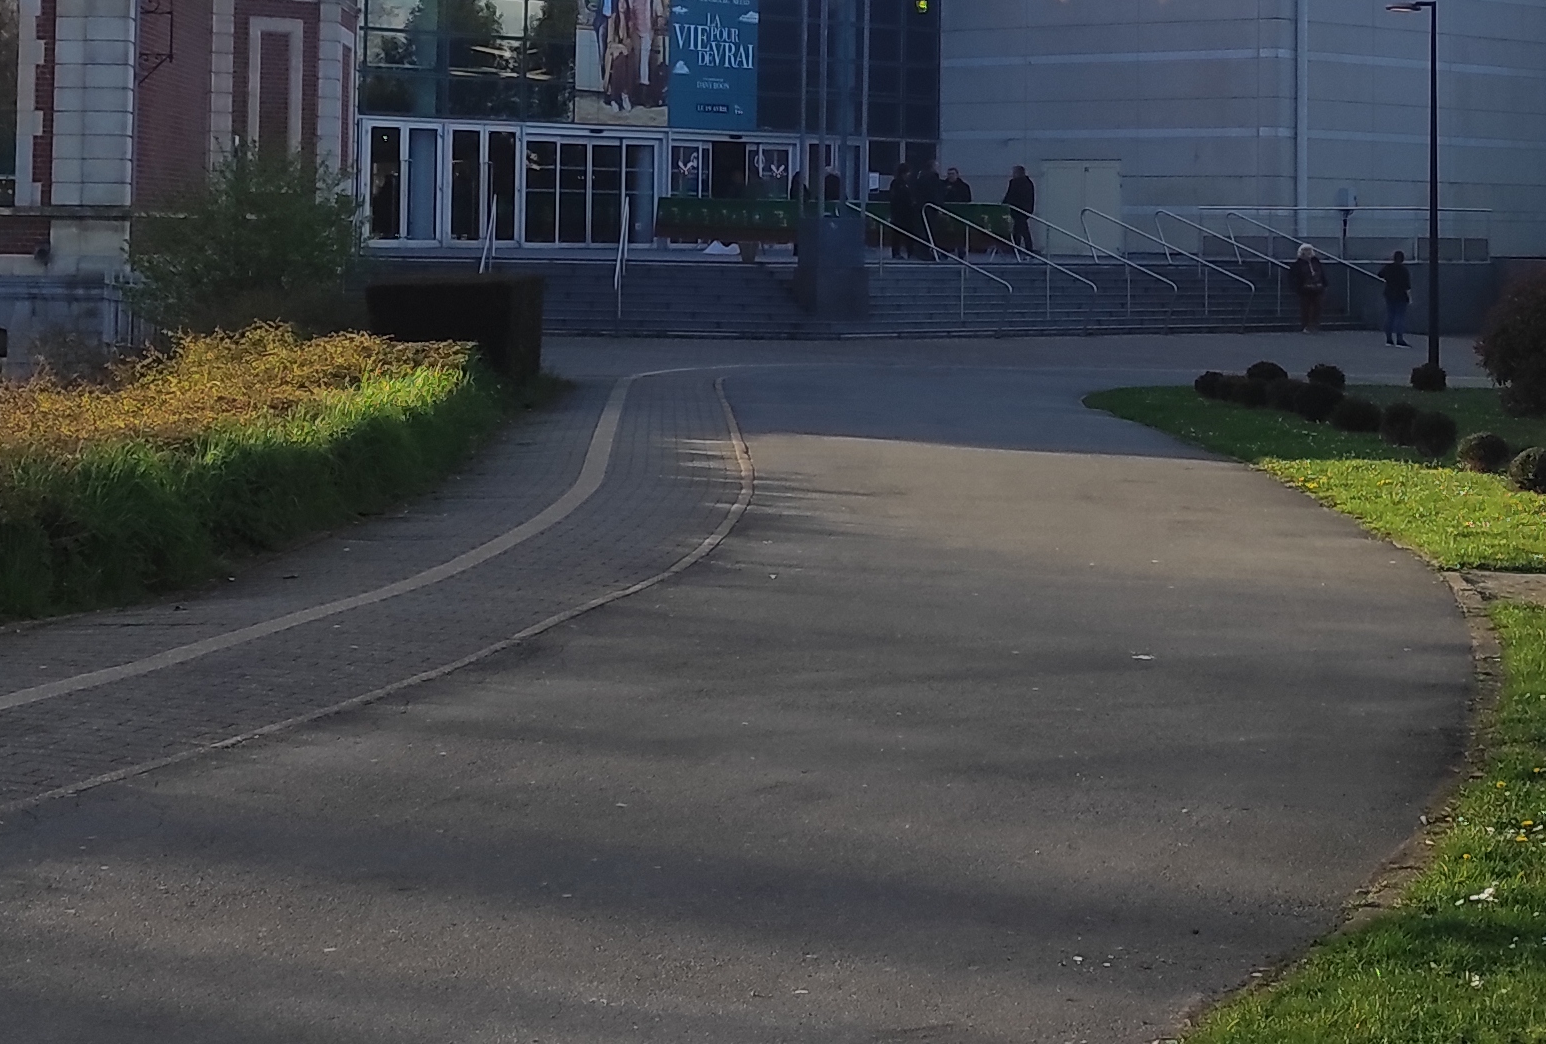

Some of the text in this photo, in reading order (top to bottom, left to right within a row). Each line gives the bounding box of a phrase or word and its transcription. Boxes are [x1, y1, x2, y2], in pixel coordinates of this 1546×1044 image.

[706, 12, 721, 27] LA
[673, 22, 739, 51] VIE POUR
[698, 41, 754, 69] DE VRAI
